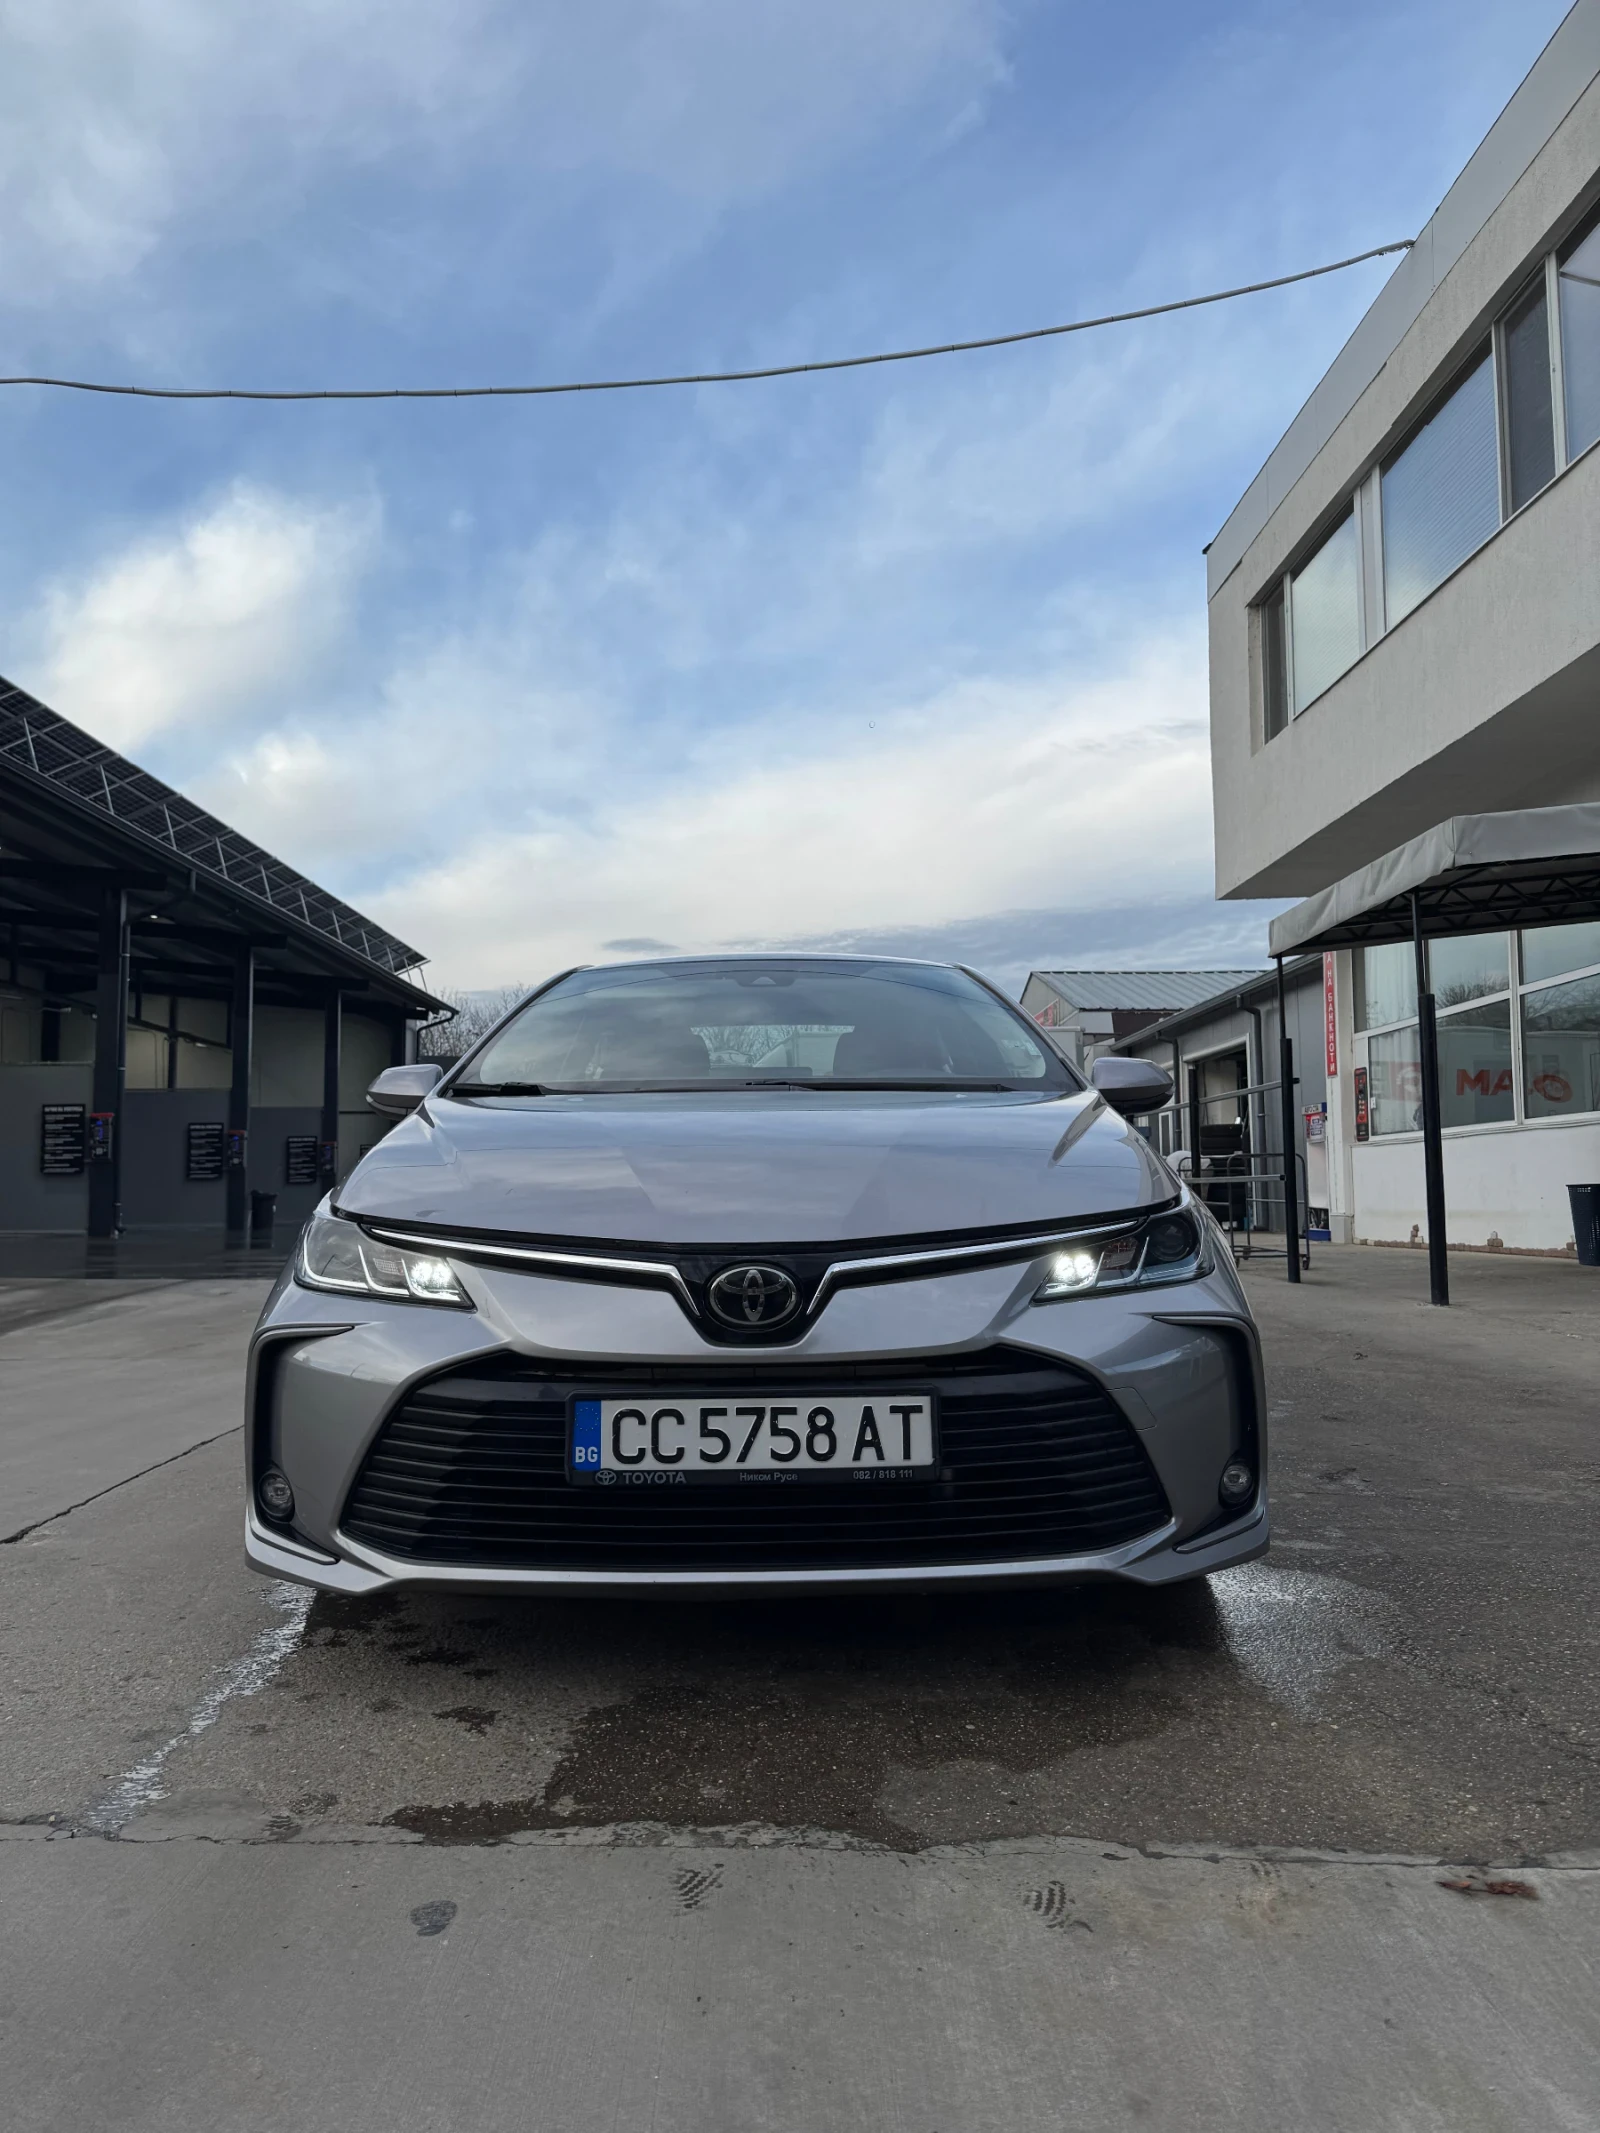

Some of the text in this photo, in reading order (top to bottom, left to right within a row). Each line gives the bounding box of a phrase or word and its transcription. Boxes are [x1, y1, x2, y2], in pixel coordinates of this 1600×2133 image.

[1327, 992, 1336, 1072] БАНКНОТИ
[575, 1405, 923, 1465] BG CC 5758 AT
[623, 1472, 687, 1485] TOYOTA
[739, 1472, 798, 1483] Ником Русе
[853, 1470, 871, 1480] 082
[878, 1469, 896, 1479] 818
[899, 1469, 913, 1478] 111
